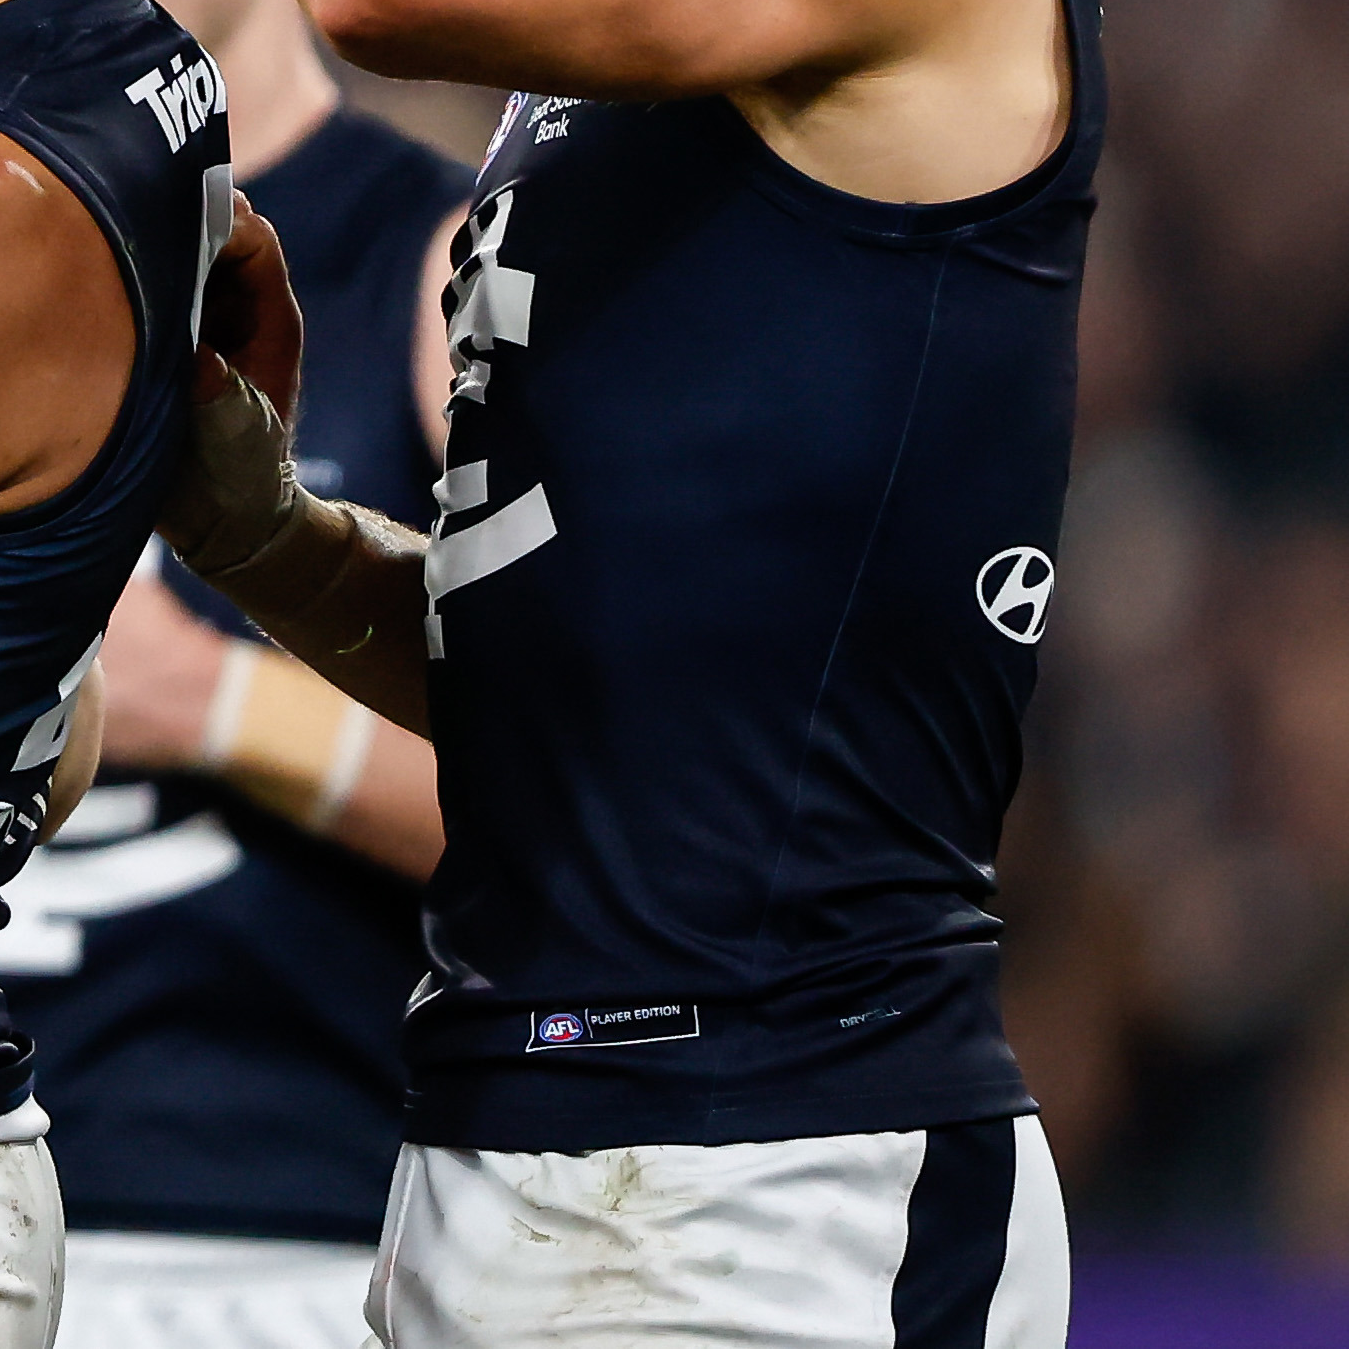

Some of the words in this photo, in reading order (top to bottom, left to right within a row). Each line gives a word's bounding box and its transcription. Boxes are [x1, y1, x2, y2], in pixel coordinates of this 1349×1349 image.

[124, 42, 228, 155] Tripl
[534, 112, 570, 145] Bank
[590, 1011, 632, 1025] PLAYER
[634, 1005, 681, 1020] EDITION
[545, 1020, 580, 1038] AFL
